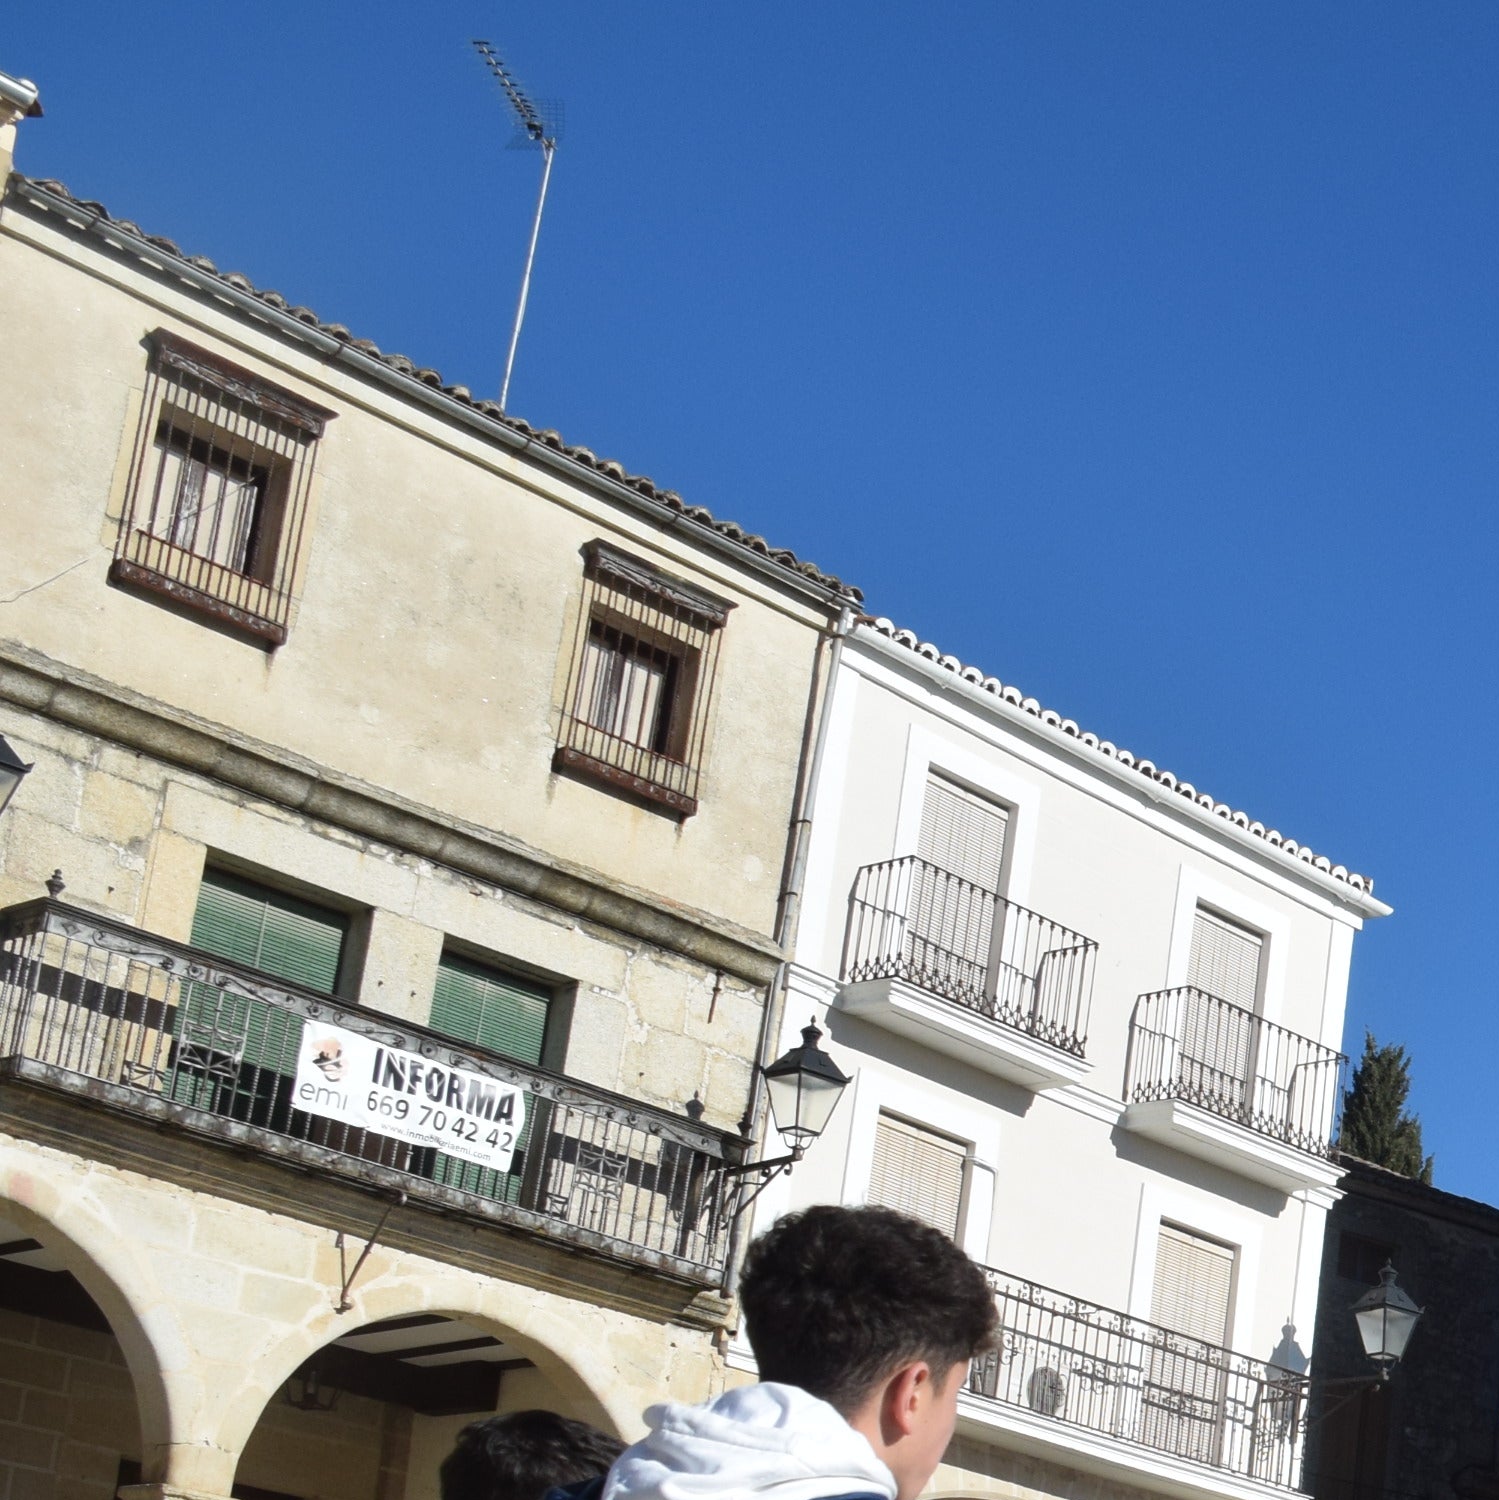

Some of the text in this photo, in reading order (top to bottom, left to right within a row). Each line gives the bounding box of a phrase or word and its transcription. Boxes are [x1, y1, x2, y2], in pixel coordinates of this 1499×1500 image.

[300, 1082, 348, 1111] emi
[371, 1047, 516, 1127] INFORMA
[367, 1090, 513, 1154] 669 70 42 42
